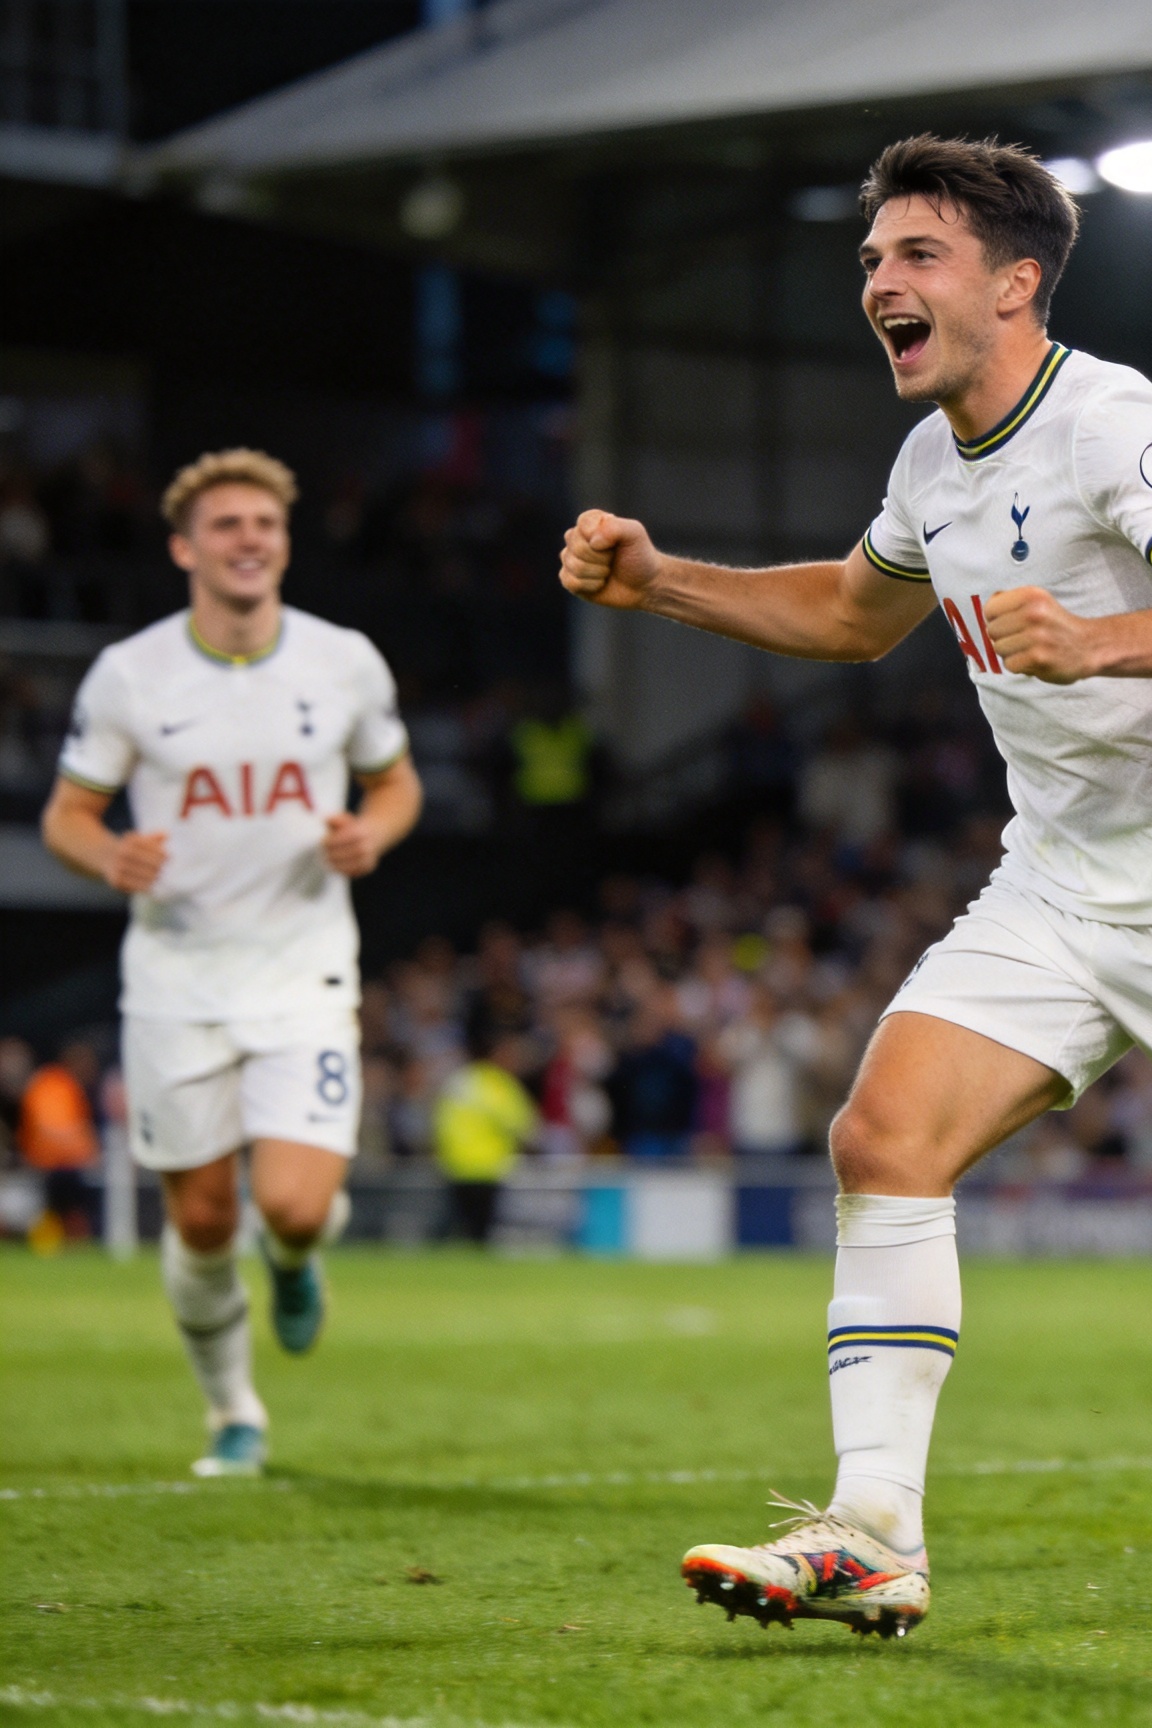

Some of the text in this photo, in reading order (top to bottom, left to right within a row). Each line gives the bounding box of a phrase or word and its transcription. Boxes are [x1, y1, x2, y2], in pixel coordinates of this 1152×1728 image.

[942, 594, 1003, 675] AI
[179, 761, 315, 820] AIA
[316, 1049, 349, 1107] 8
